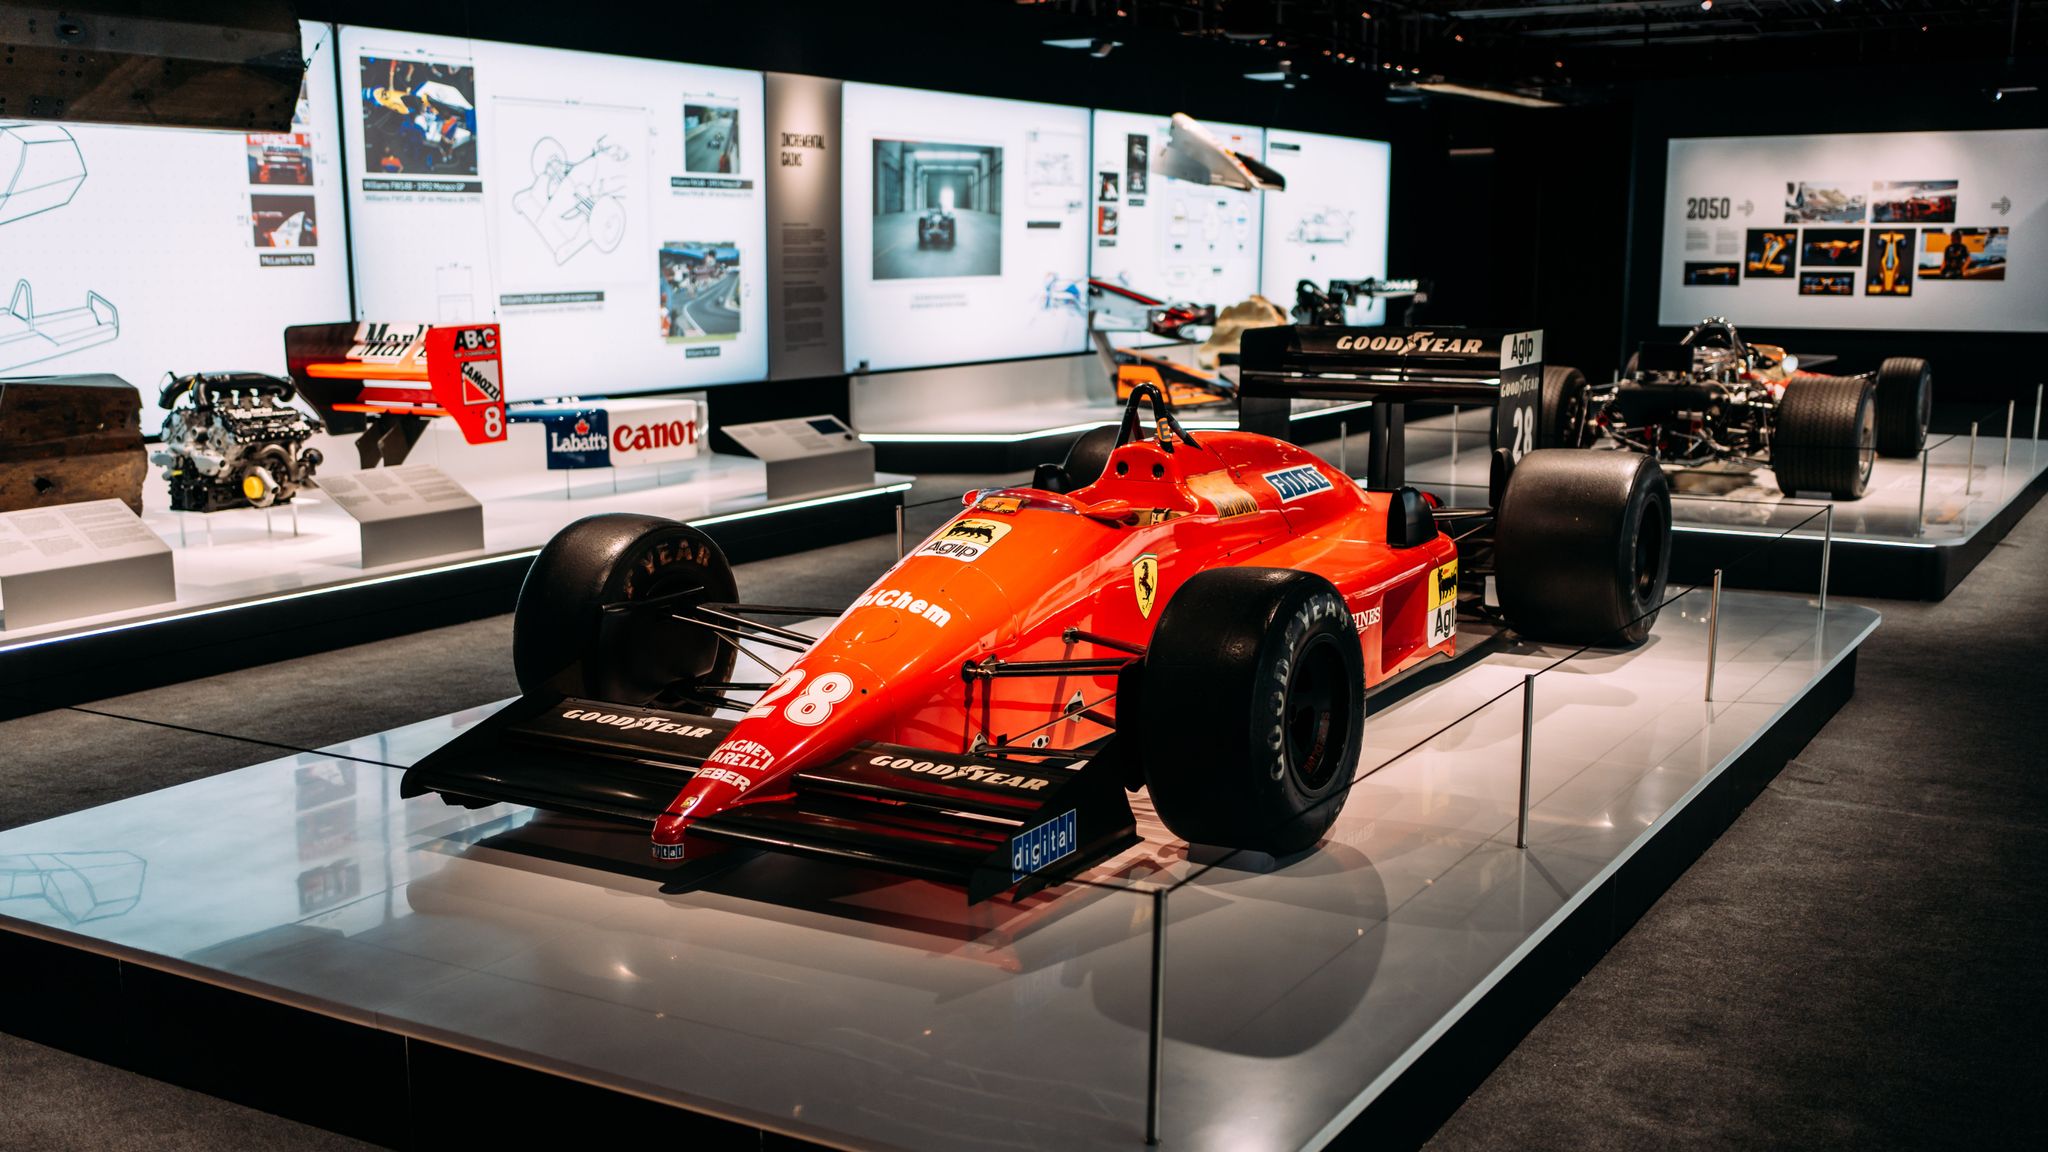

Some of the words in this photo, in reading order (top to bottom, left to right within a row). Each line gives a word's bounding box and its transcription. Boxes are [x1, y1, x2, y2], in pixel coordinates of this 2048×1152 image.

[781, 132, 825, 149] INCREMENTAL
[781, 151, 802, 166] GAINS
[1686, 197, 1731, 220] 2050
[454, 328, 497, 350] ABAC
[1510, 334, 1534, 365] Agip
[461, 361, 500, 402] CAMOZZI
[484, 406, 503, 438] 8
[1512, 405, 1534, 464] 28
[551, 432, 608, 453] Labatt's
[1271, 470, 1325, 495] FIAT
[923, 540, 978, 558] Agip
[853, 589, 951, 628] niChem
[1434, 601, 1456, 638] Agi
[744, 668, 853, 727] 28
[1014, 821, 1073, 871] digital
